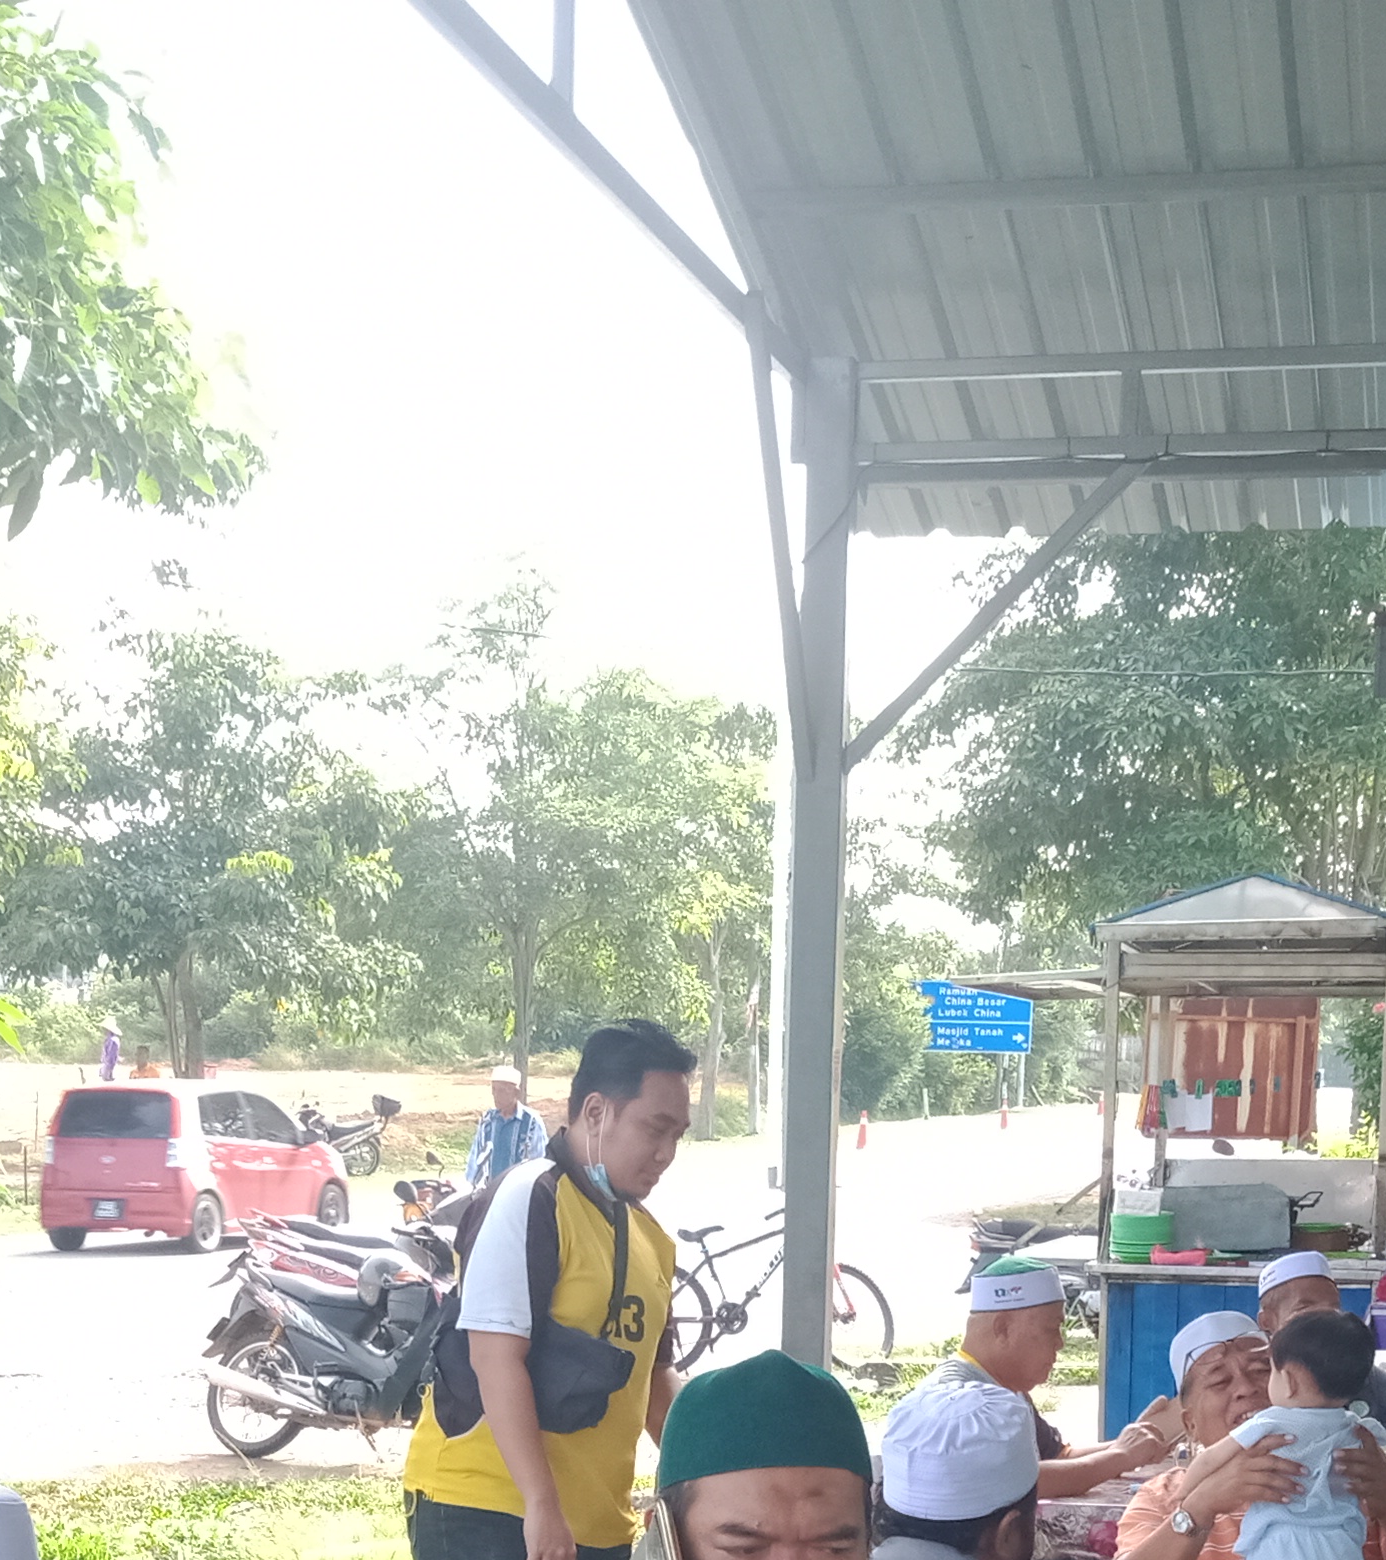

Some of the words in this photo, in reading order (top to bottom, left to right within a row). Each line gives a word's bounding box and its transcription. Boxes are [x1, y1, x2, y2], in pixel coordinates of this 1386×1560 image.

[944, 997, 973, 1006] China
[976, 997, 1007, 1007] Besar
[973, 1008, 1002, 1018] China
[936, 1026, 969, 1038] Masjid
[974, 1027, 1004, 1037] Tanah
[936, 1037, 972, 1048] Meka
